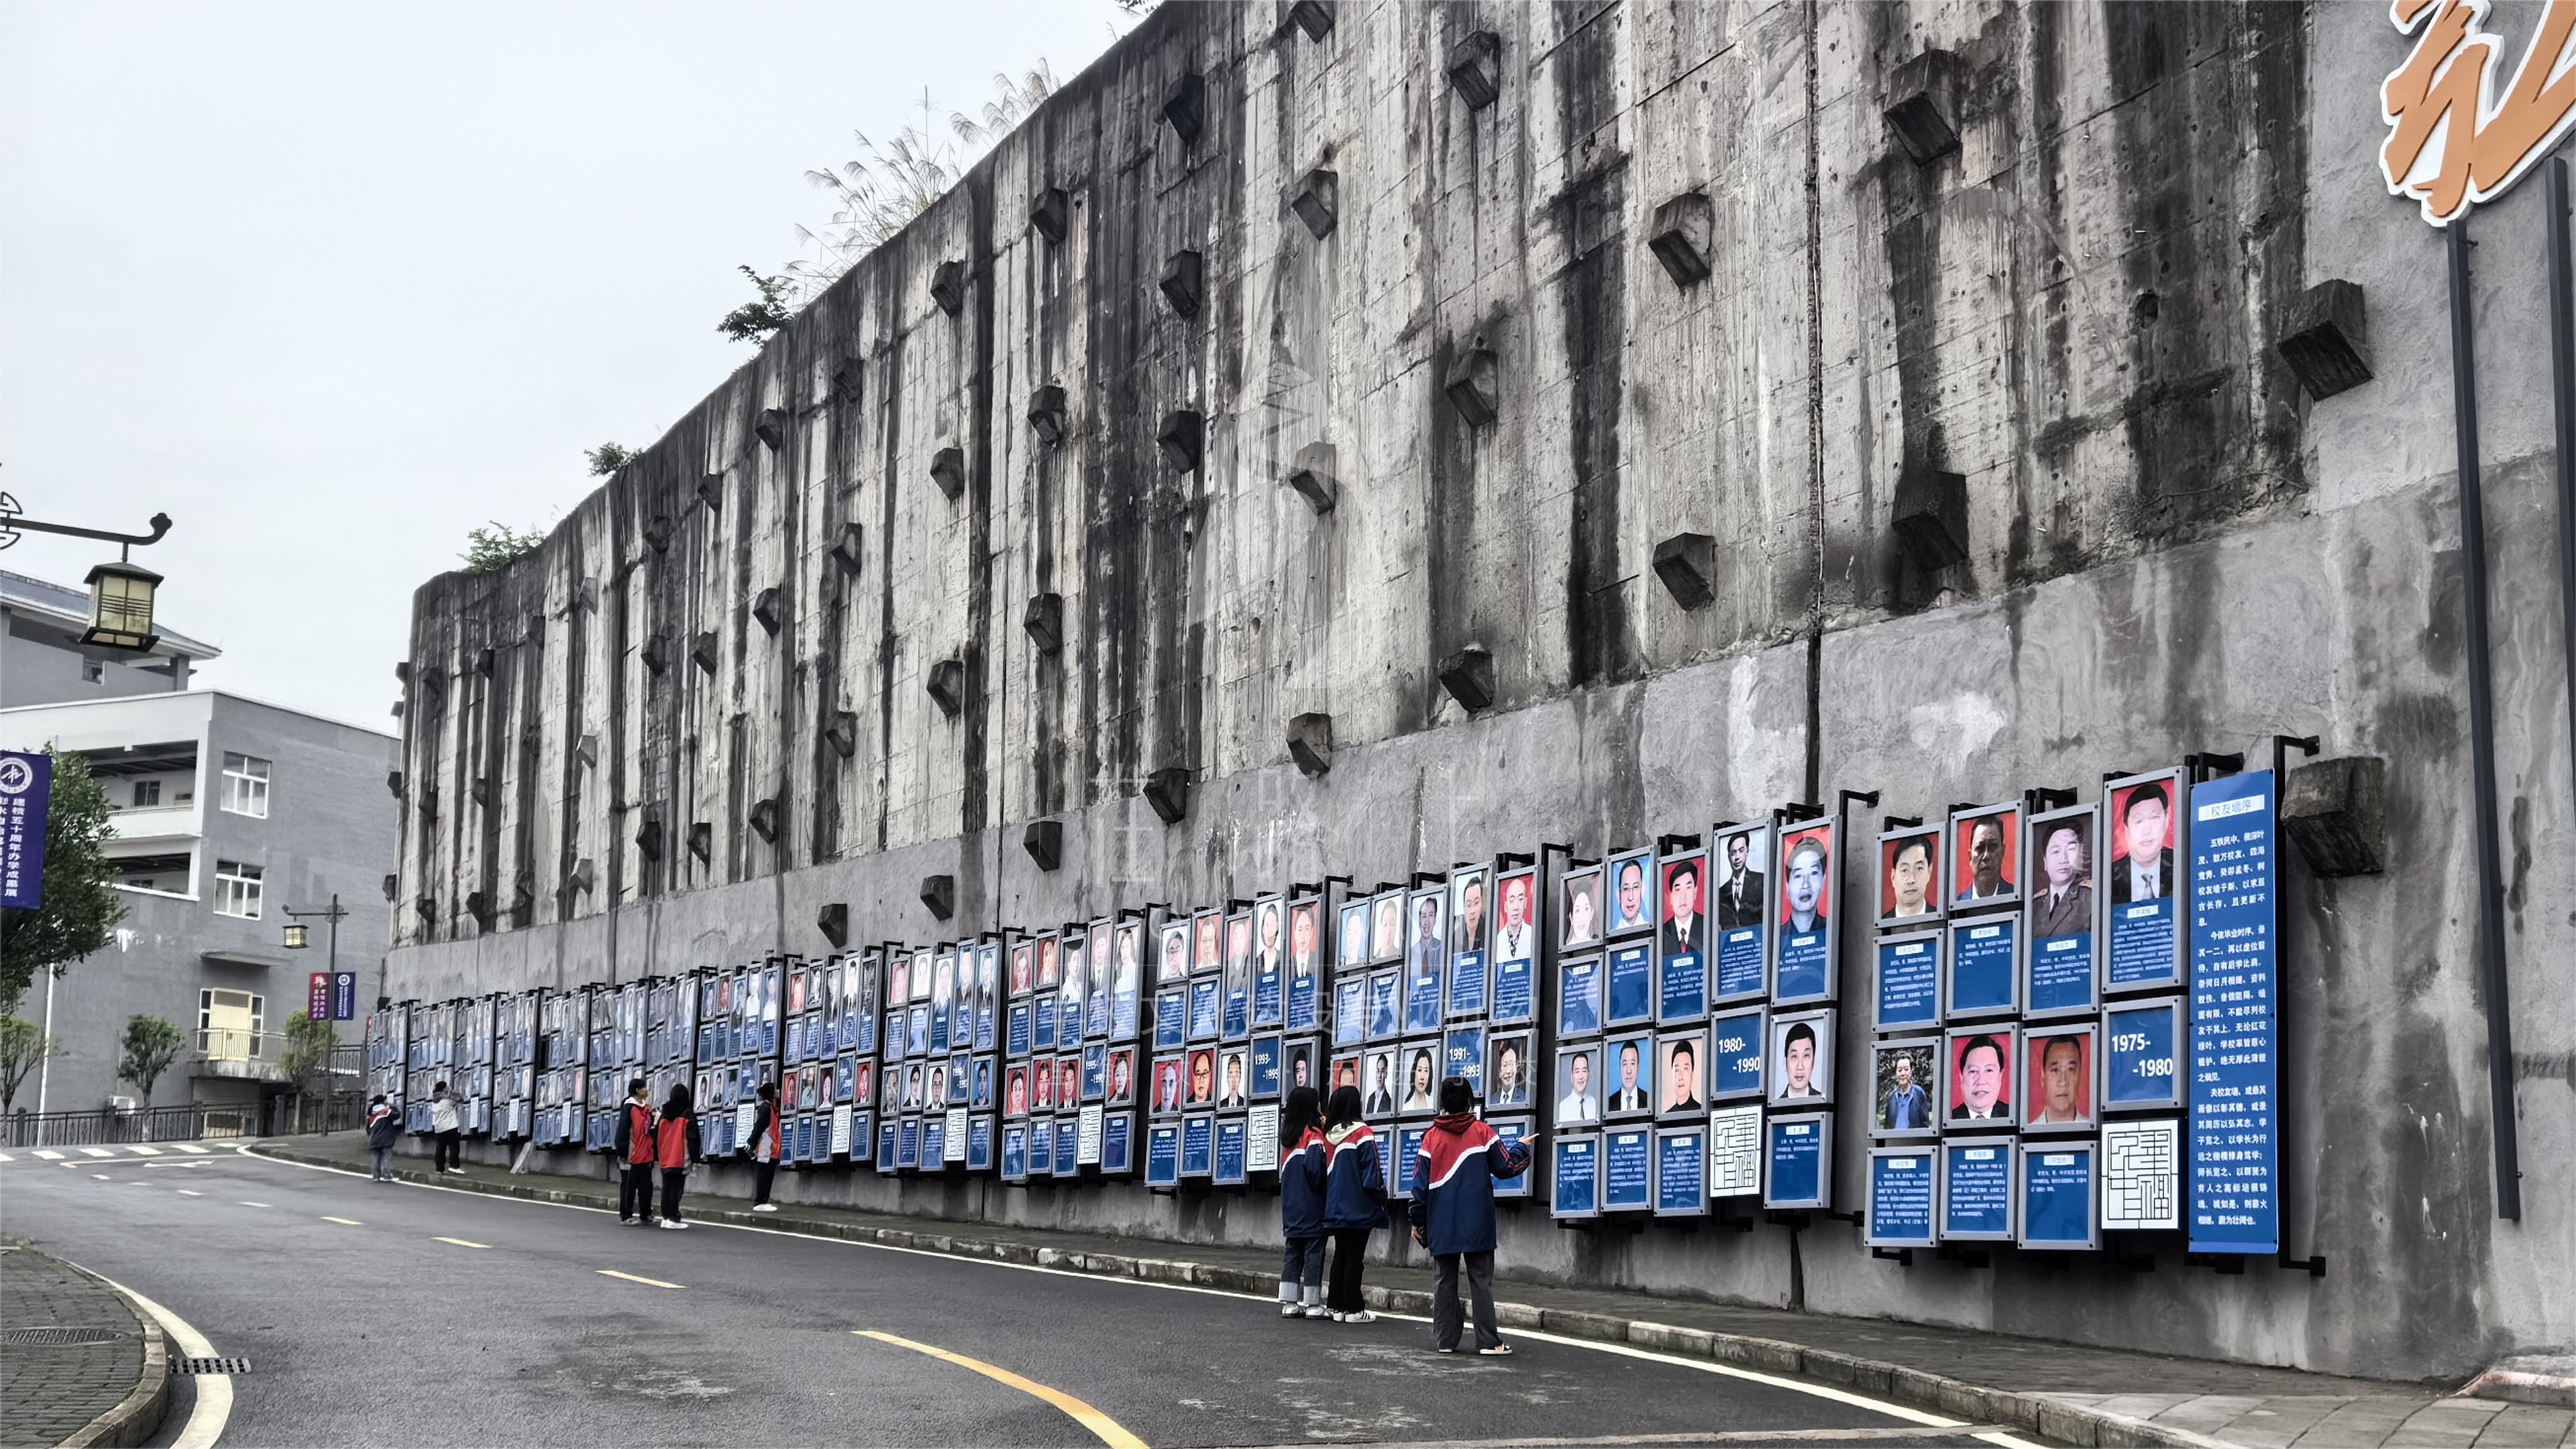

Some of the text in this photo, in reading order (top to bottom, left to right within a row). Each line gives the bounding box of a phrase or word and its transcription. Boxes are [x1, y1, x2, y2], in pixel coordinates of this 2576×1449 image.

[2211, 799, 2252, 818] 校友墙序
[1718, 1036, 1746, 1054] 1980-
[2111, 1033, 2151, 1053] 1975-
[1255, 1053, 1270, 1065] 1993-
[1449, 1046, 1470, 1061] 1991-
[1459, 1064, 1480, 1077] -1993
[1733, 1056, 1760, 1073] -1990
[2133, 1058, 2174, 1077] -1980
